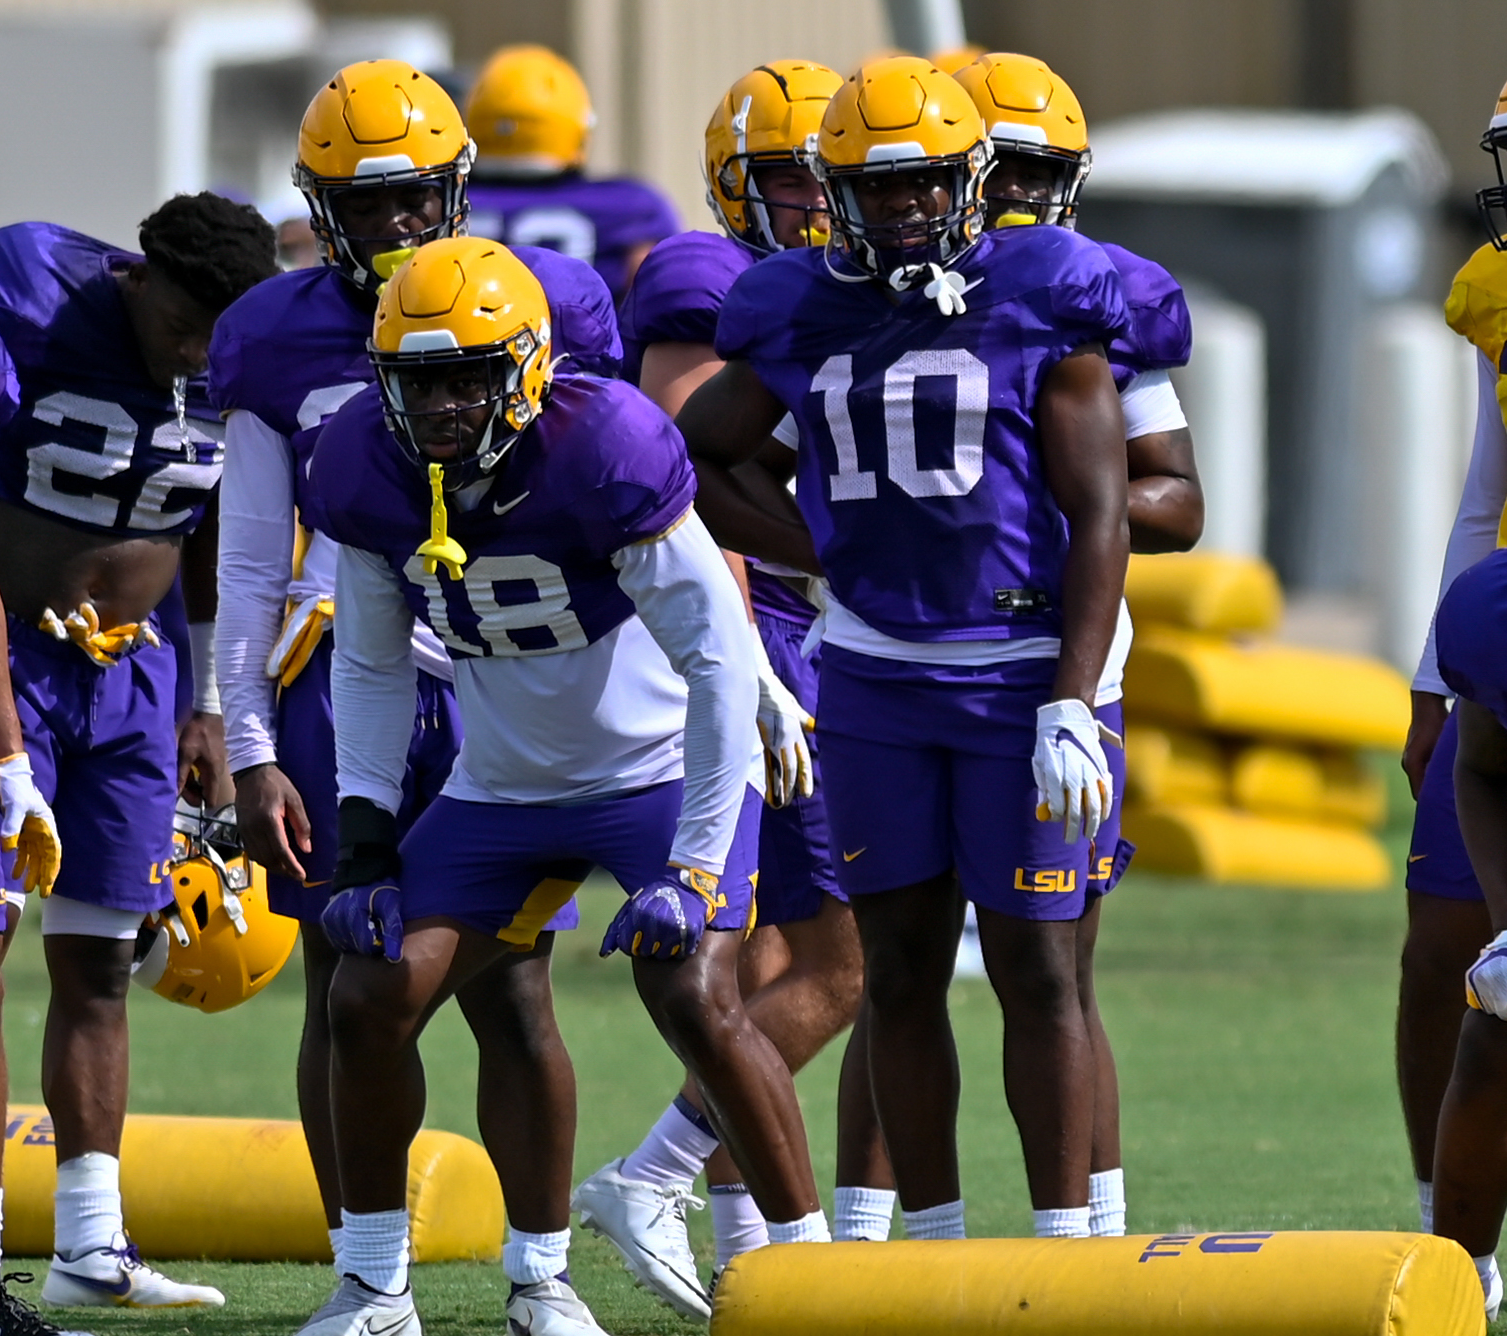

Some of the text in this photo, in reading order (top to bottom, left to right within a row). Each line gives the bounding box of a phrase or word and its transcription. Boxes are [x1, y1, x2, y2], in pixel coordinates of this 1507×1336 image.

[23, 390, 226, 531] 22
[809, 346, 991, 502] 10
[401, 553, 589, 659] 18
[1013, 867, 1077, 892] LSU
